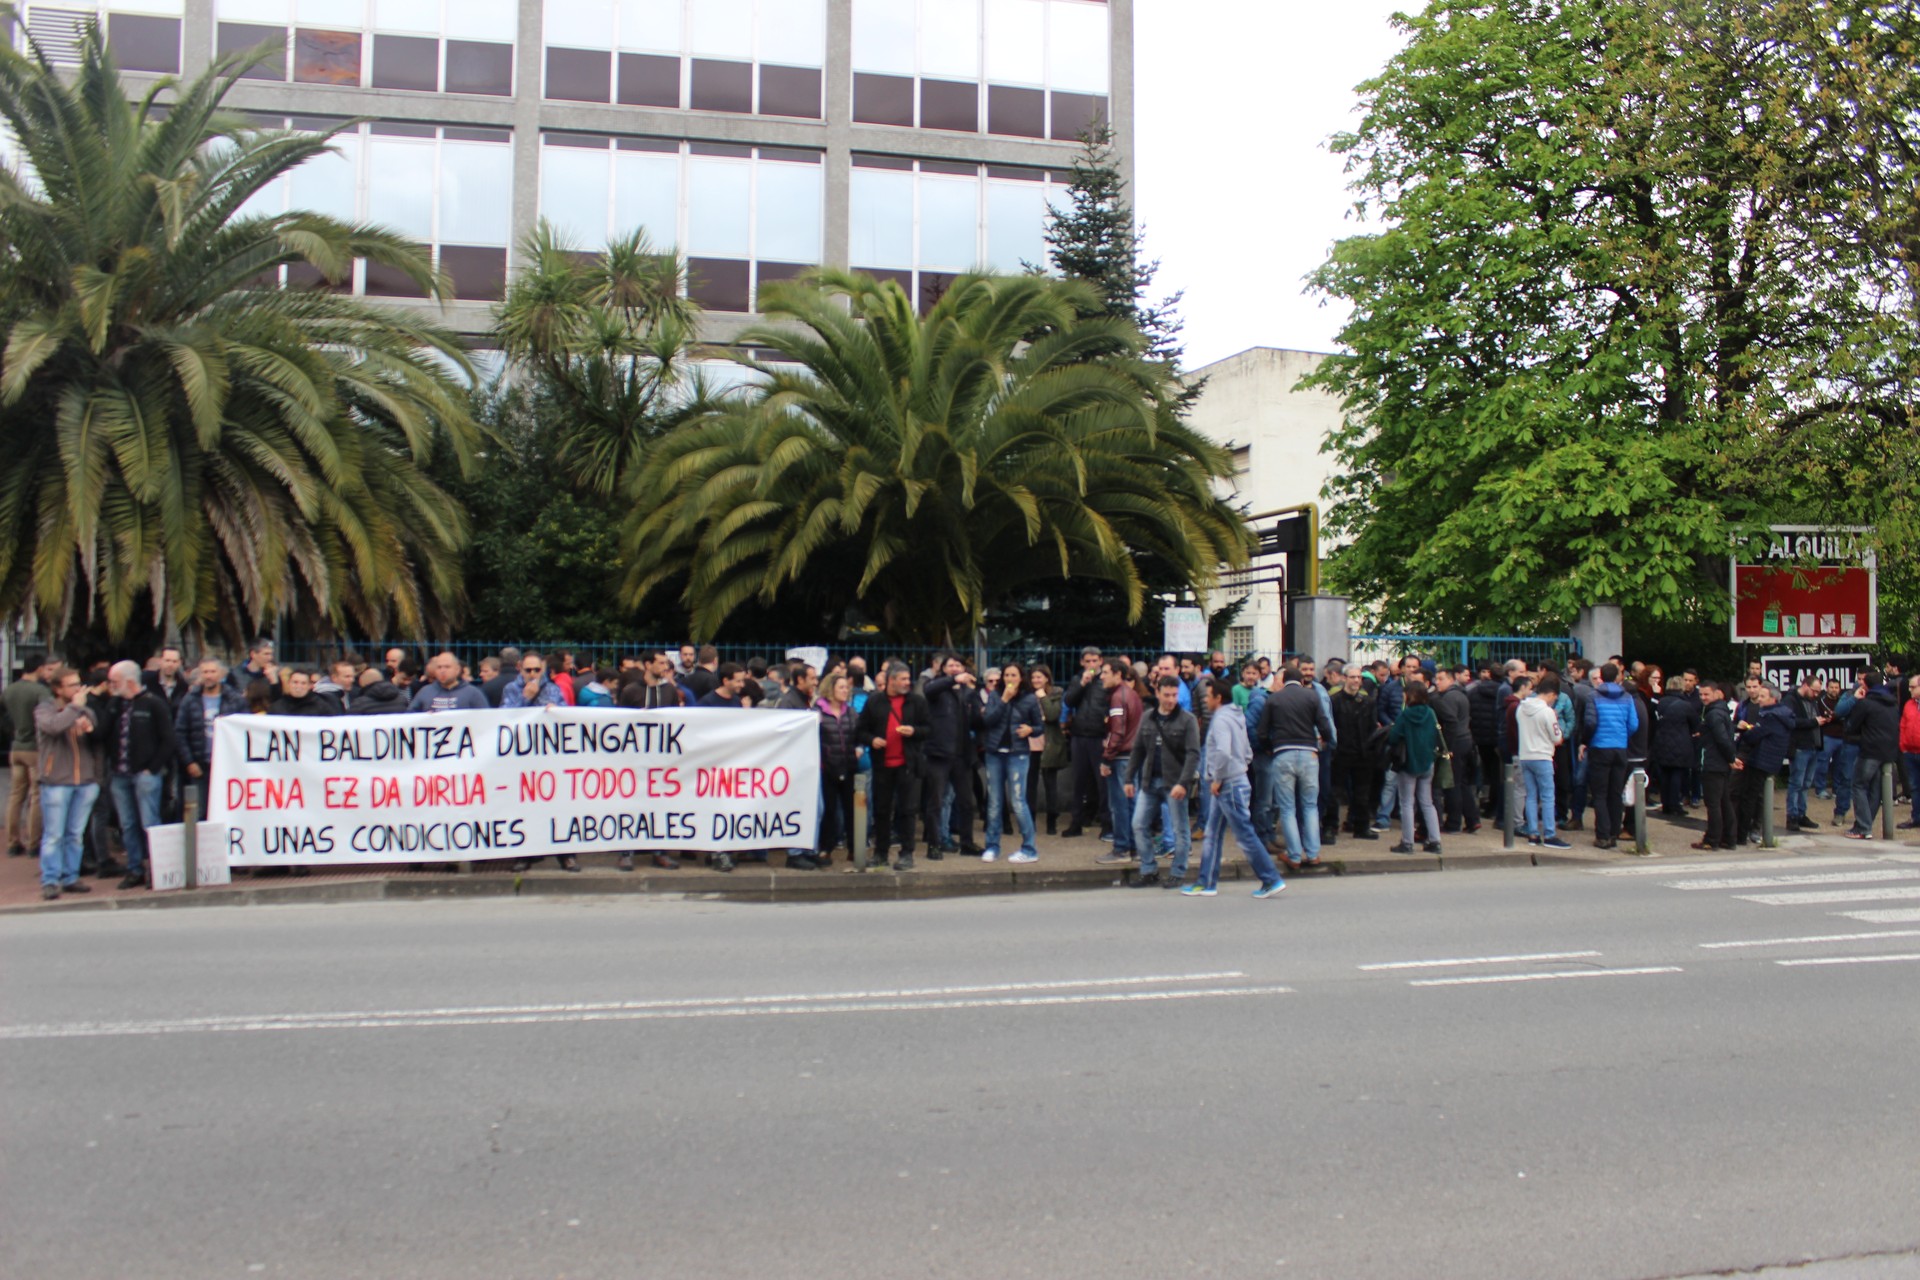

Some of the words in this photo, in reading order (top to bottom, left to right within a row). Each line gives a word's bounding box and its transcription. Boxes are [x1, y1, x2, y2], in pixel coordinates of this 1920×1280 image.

[1768, 669, 1790, 691] SE
[245, 729, 300, 763] LAN
[319, 726, 475, 762] BALDINTZA
[497, 722, 686, 758] DUINENGATIK
[227, 777, 304, 811] DENA
[324, 776, 359, 810] EZ
[371, 776, 402, 809] DA
[413, 773, 486, 808] DIRUA
[519, 770, 556, 803] NO
[563, 767, 637, 801] TODO
[646, 766, 682, 798] ES
[695, 766, 790, 799] DINERO
[263, 825, 335, 855] UNAS
[350, 818, 526, 853] CONDICIONES
[550, 811, 697, 845] LABORALES
[711, 810, 801, 842] DIGNAS
